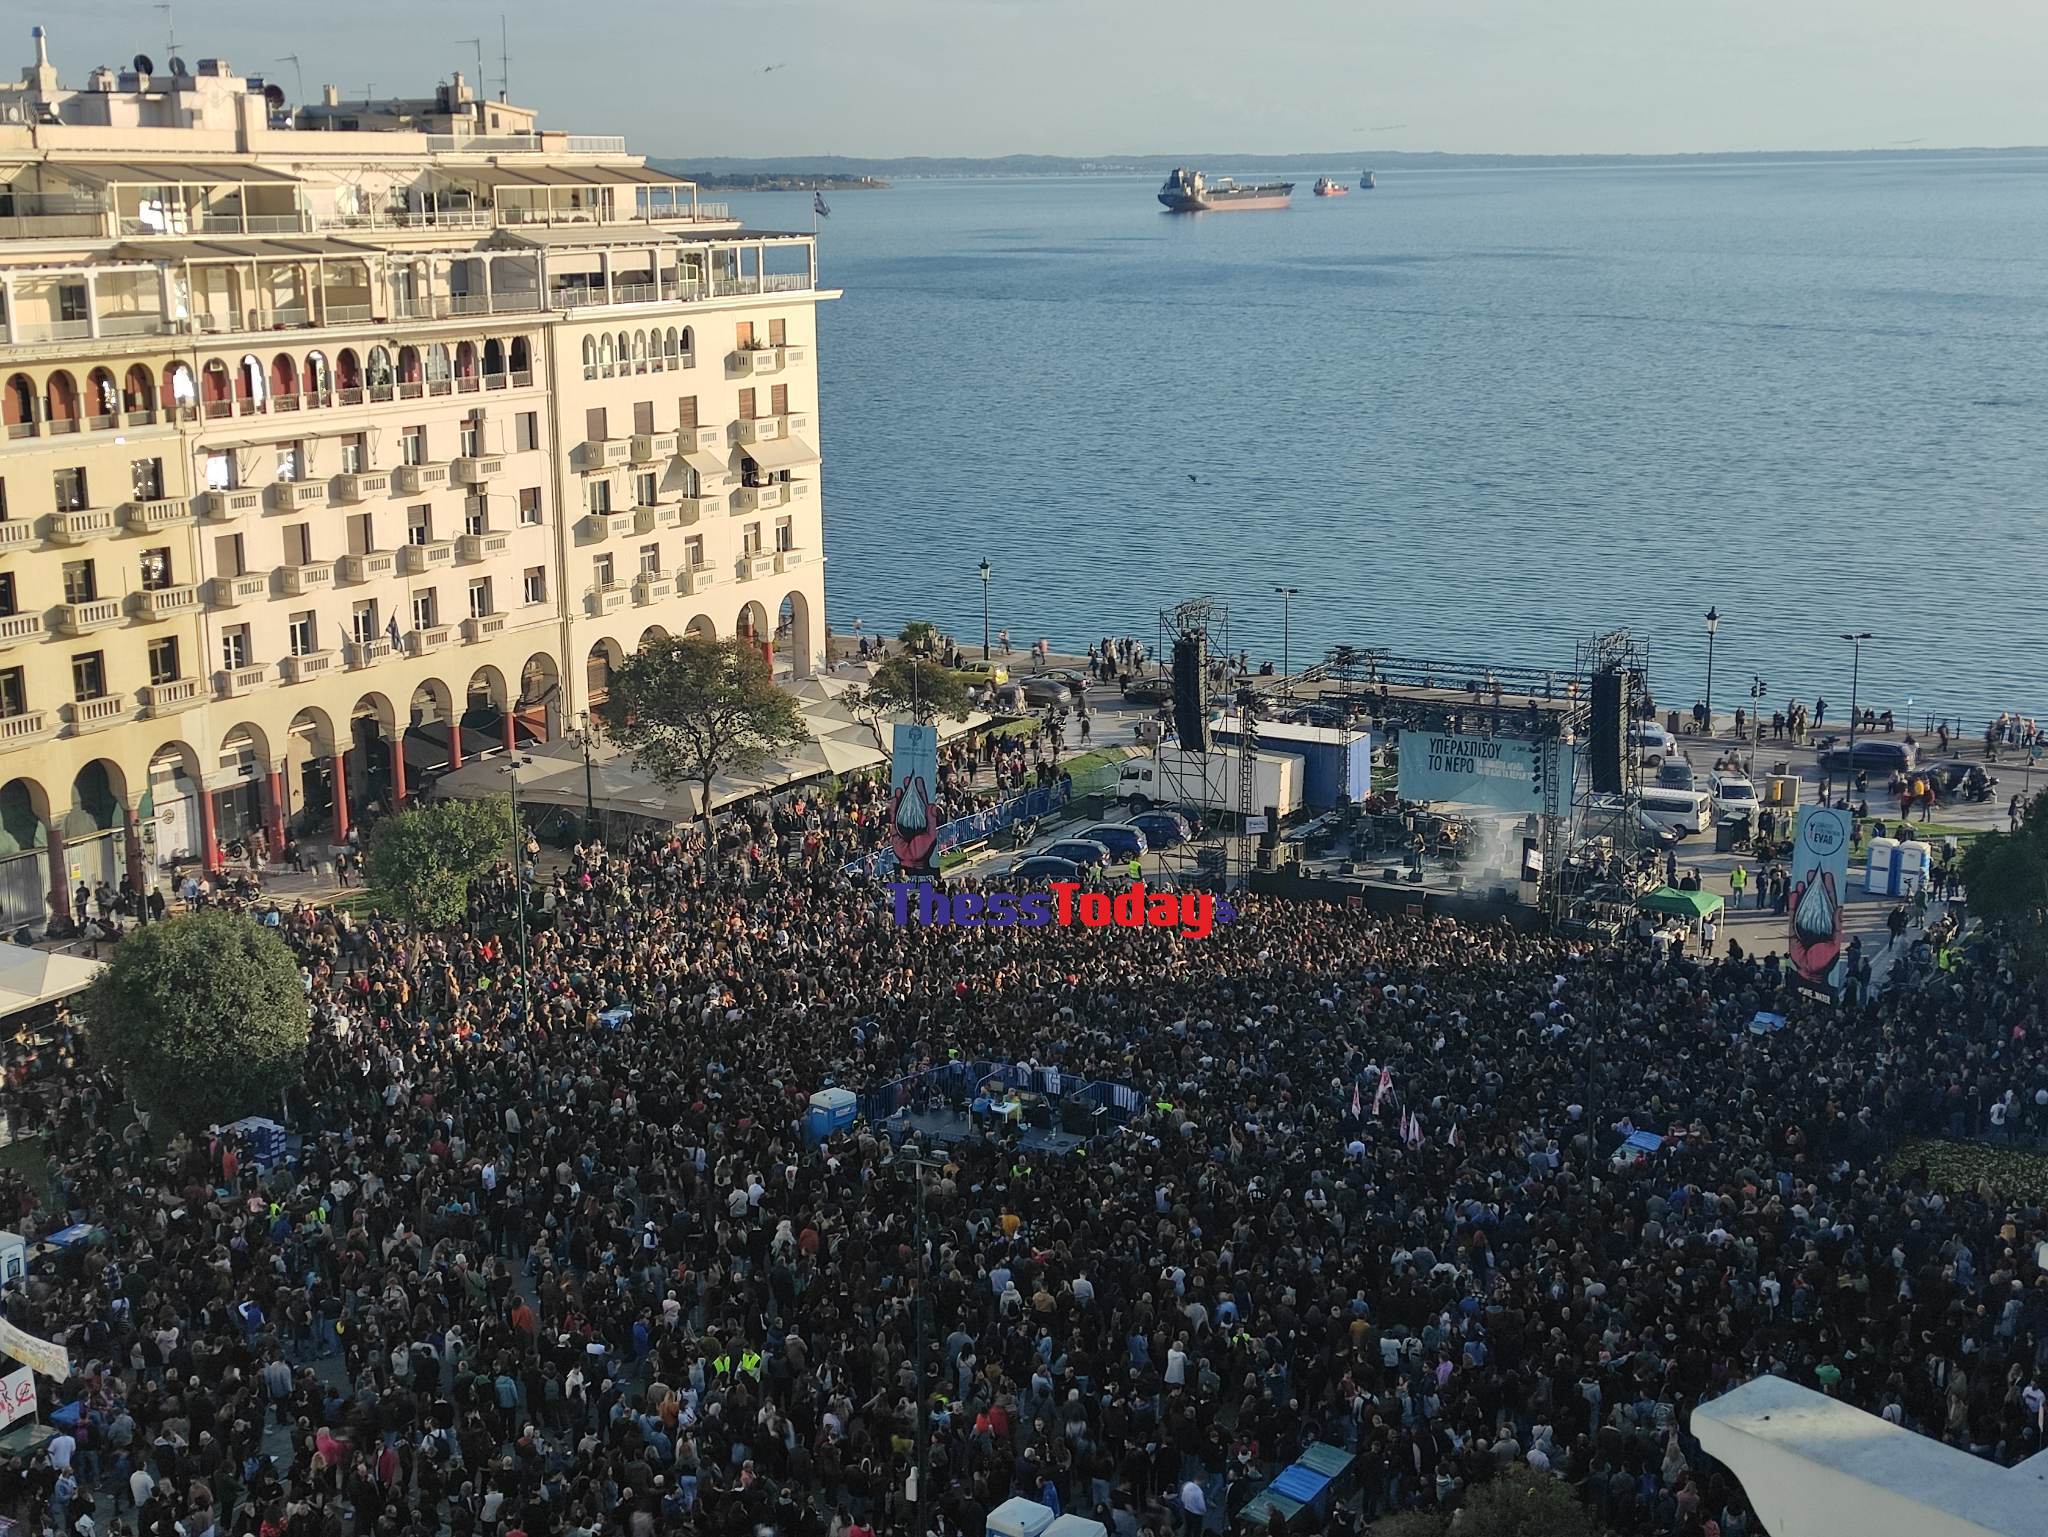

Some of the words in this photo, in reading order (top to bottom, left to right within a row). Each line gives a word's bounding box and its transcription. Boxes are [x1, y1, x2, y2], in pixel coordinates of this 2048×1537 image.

[1430, 738, 1502, 759] ΥΠΕΡΑΣΠΙΣΟΥ
[1428, 755, 1442, 771] ΤΟ
[1444, 757, 1475, 774] ΝΕΡΟ
